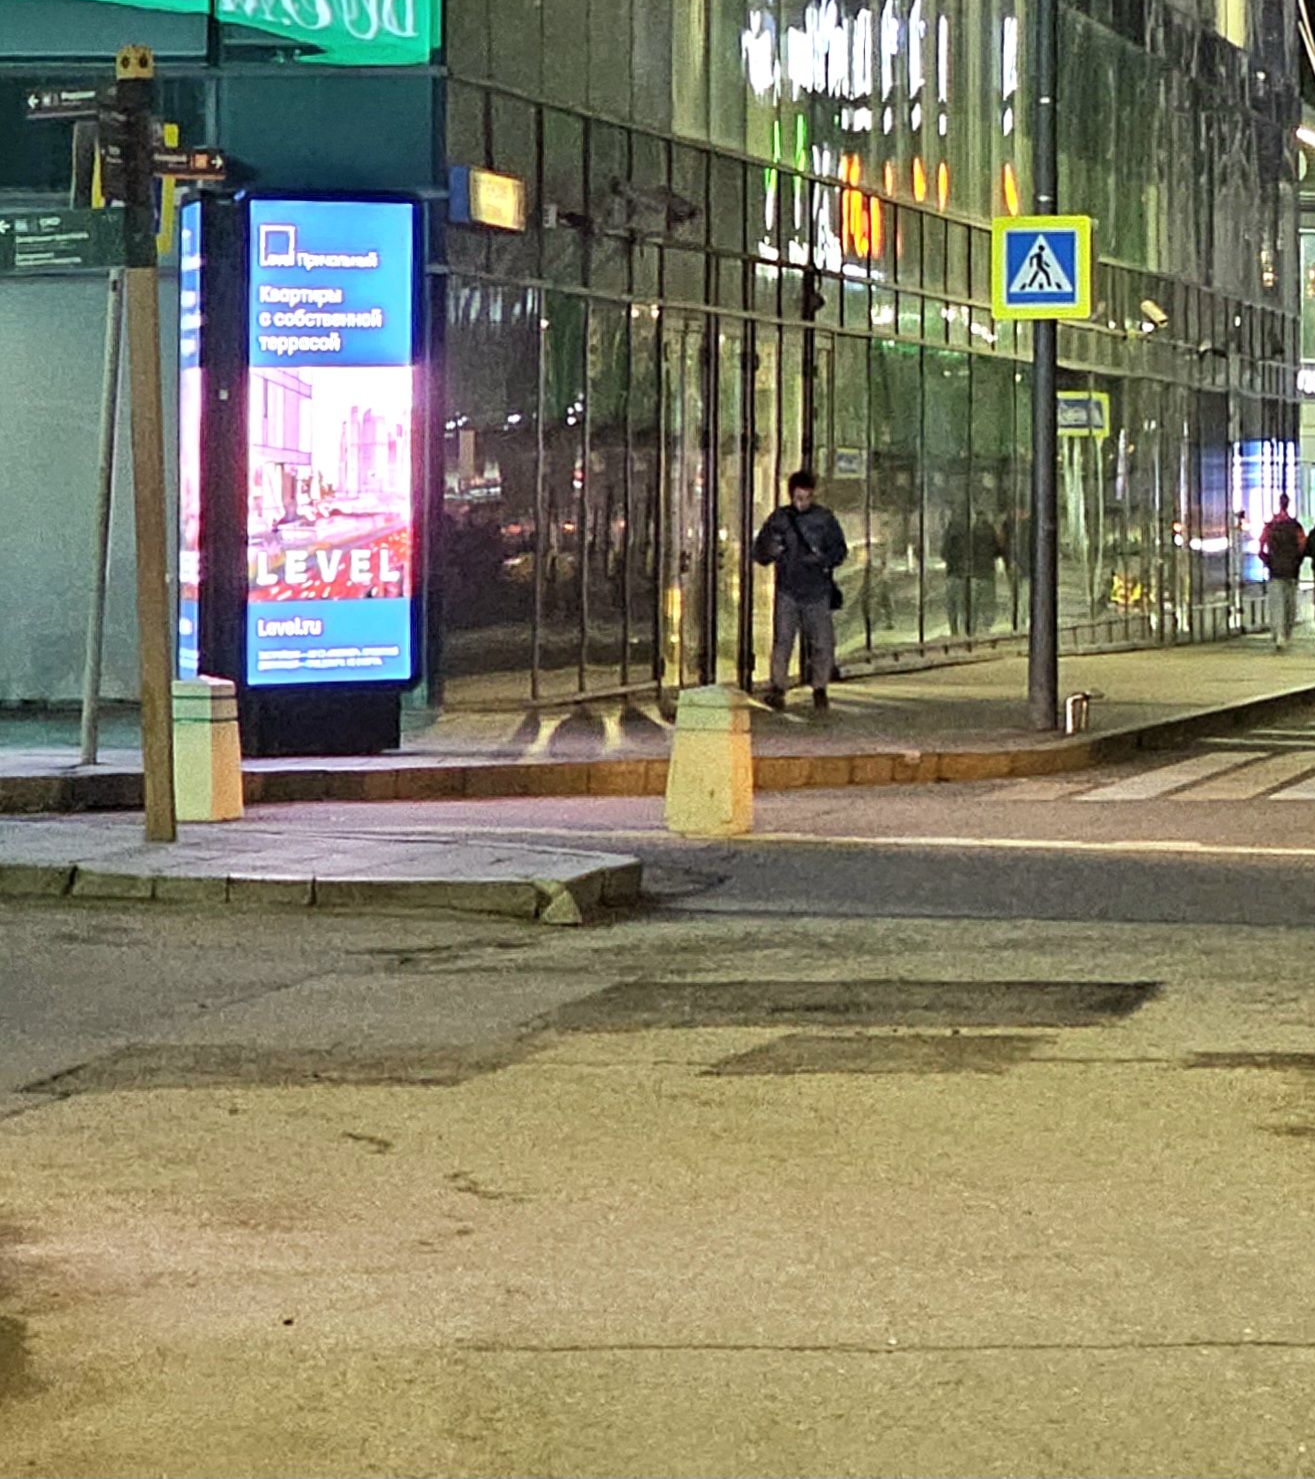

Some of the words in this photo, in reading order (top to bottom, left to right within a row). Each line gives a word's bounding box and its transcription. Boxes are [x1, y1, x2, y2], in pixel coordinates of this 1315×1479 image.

[259, 285, 343, 308] Квартиры
[258, 311, 272, 327] с
[273, 308, 383, 328] собственной
[258, 332, 341, 356] террасой
[255, 548, 401, 586] LEVEL
[257, 617, 322, 637] Level.ru
